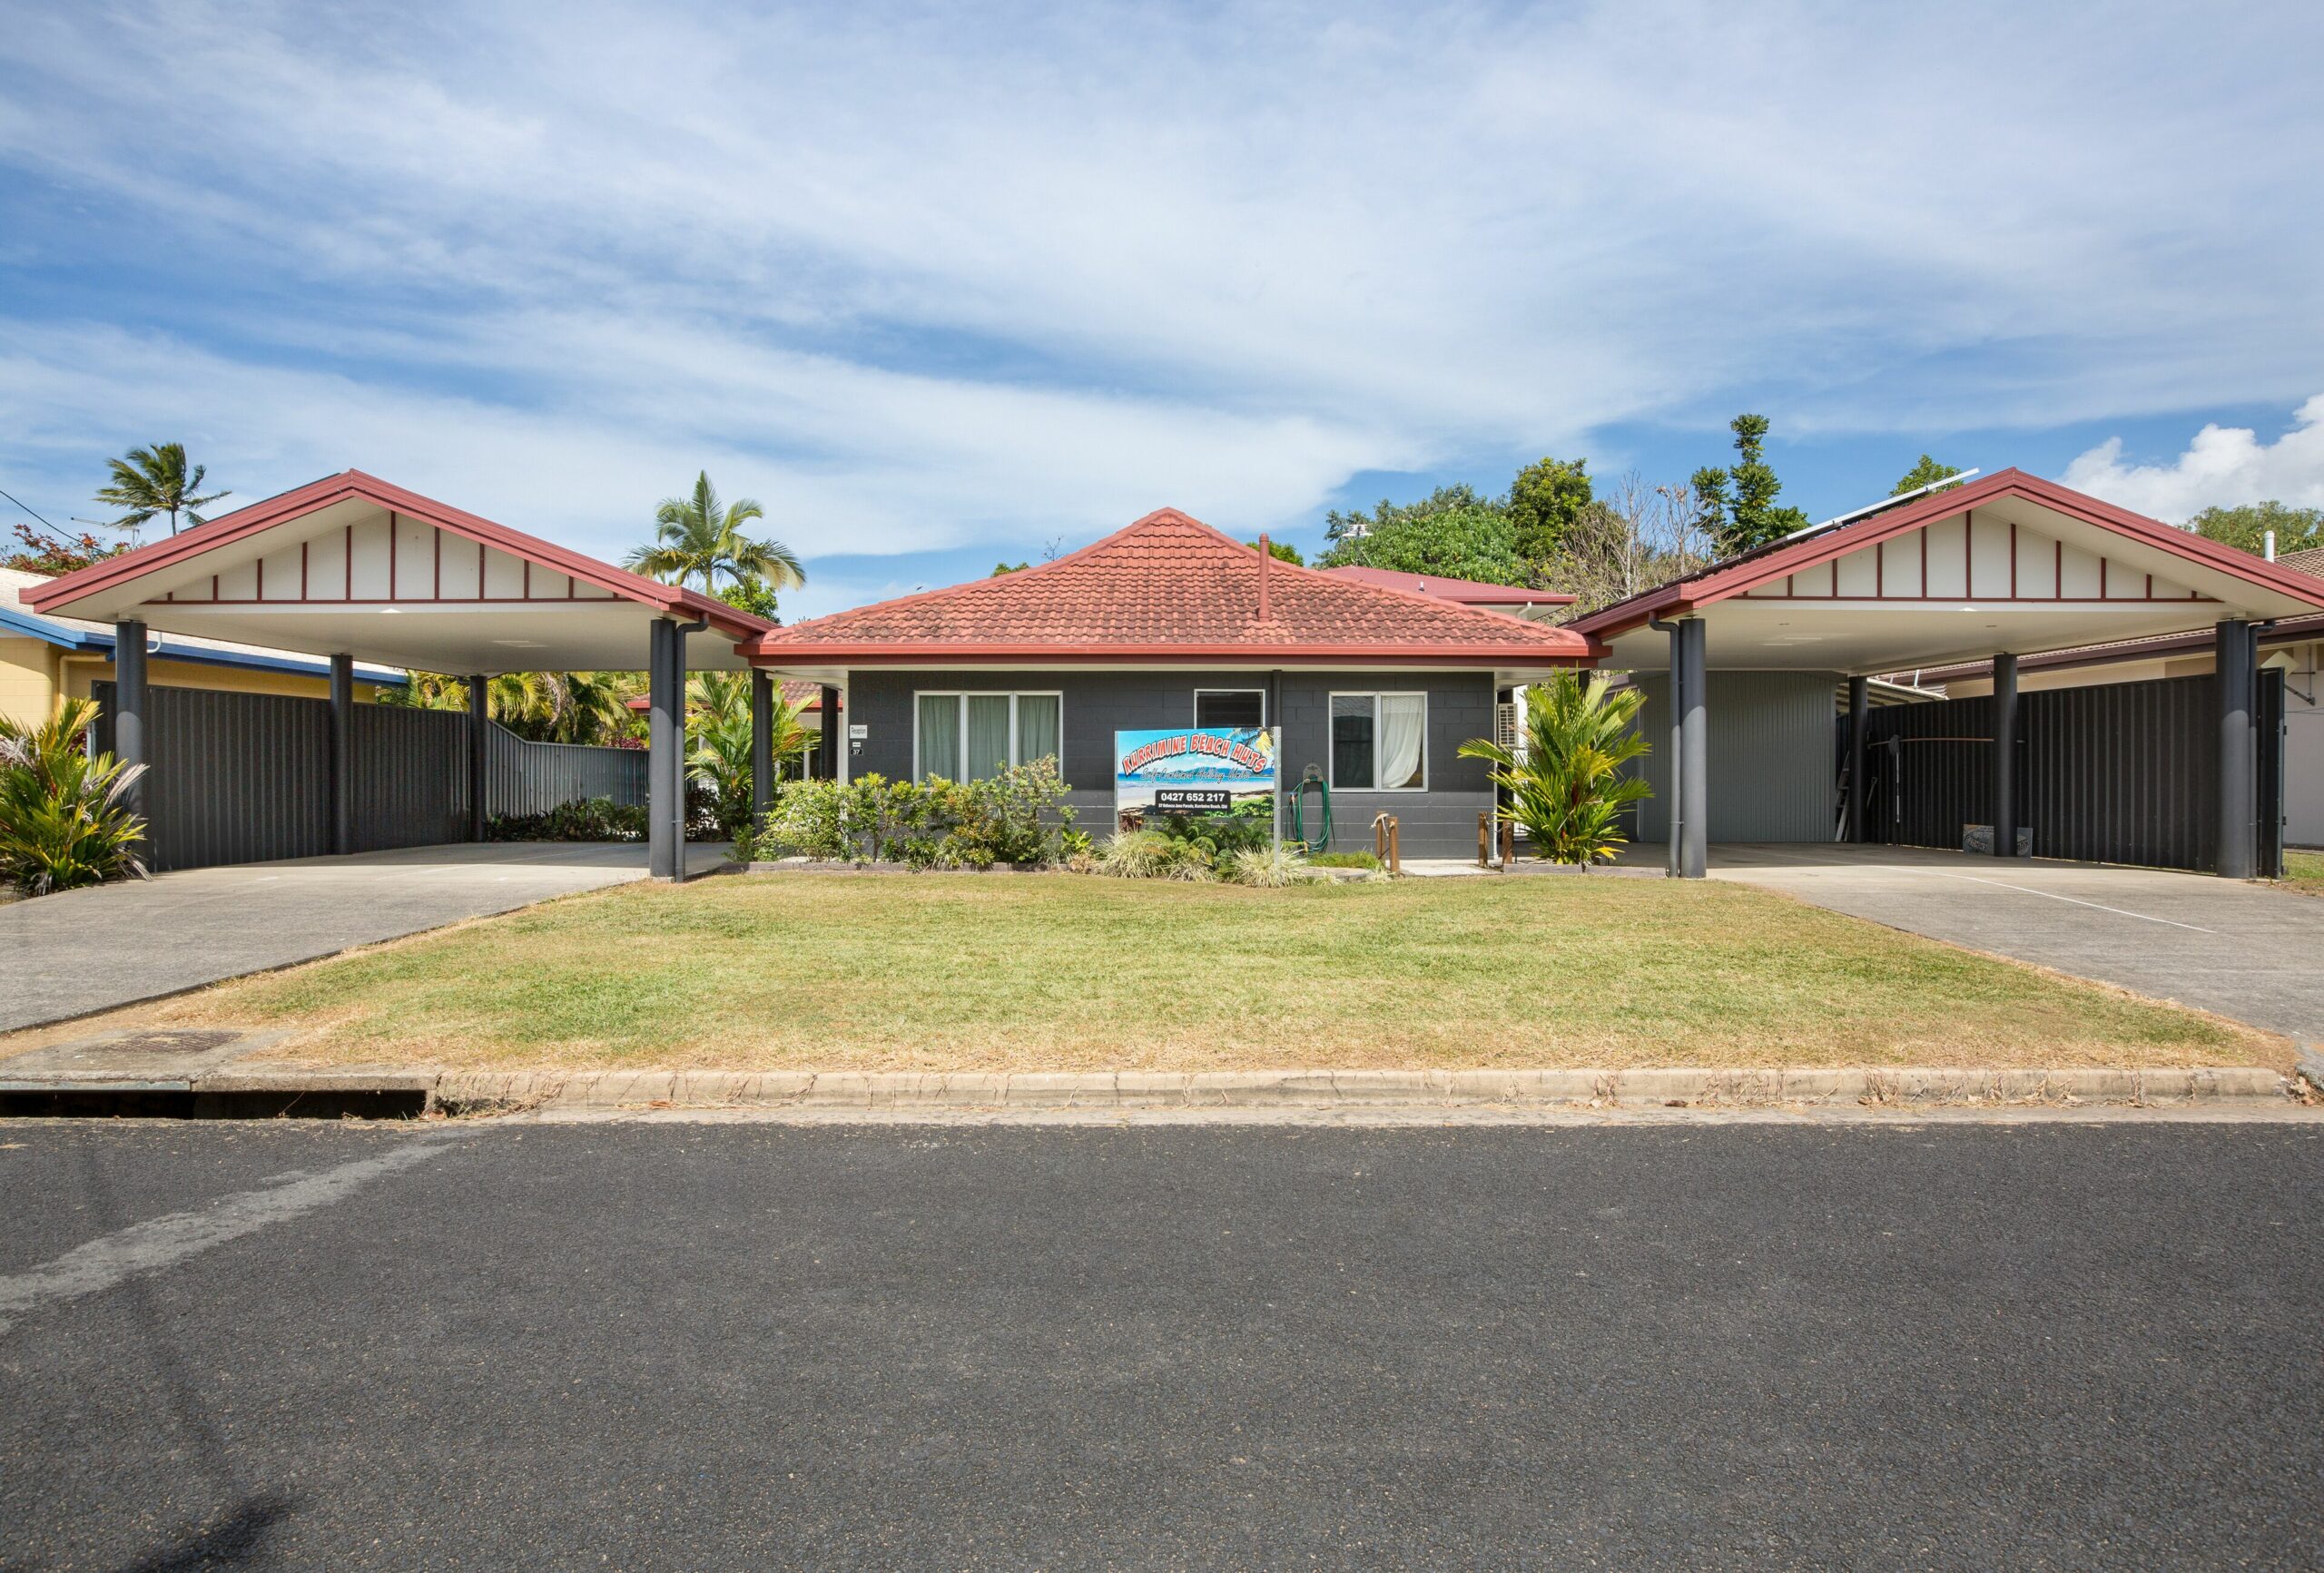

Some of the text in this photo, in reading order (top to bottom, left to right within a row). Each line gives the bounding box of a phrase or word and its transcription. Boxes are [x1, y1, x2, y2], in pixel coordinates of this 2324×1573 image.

[1122, 733, 1267, 776] KURRIMINE BEACH HUTS
[1196, 767, 1224, 783] Holiday
[1161, 792, 1226, 801] 0427 652 217
